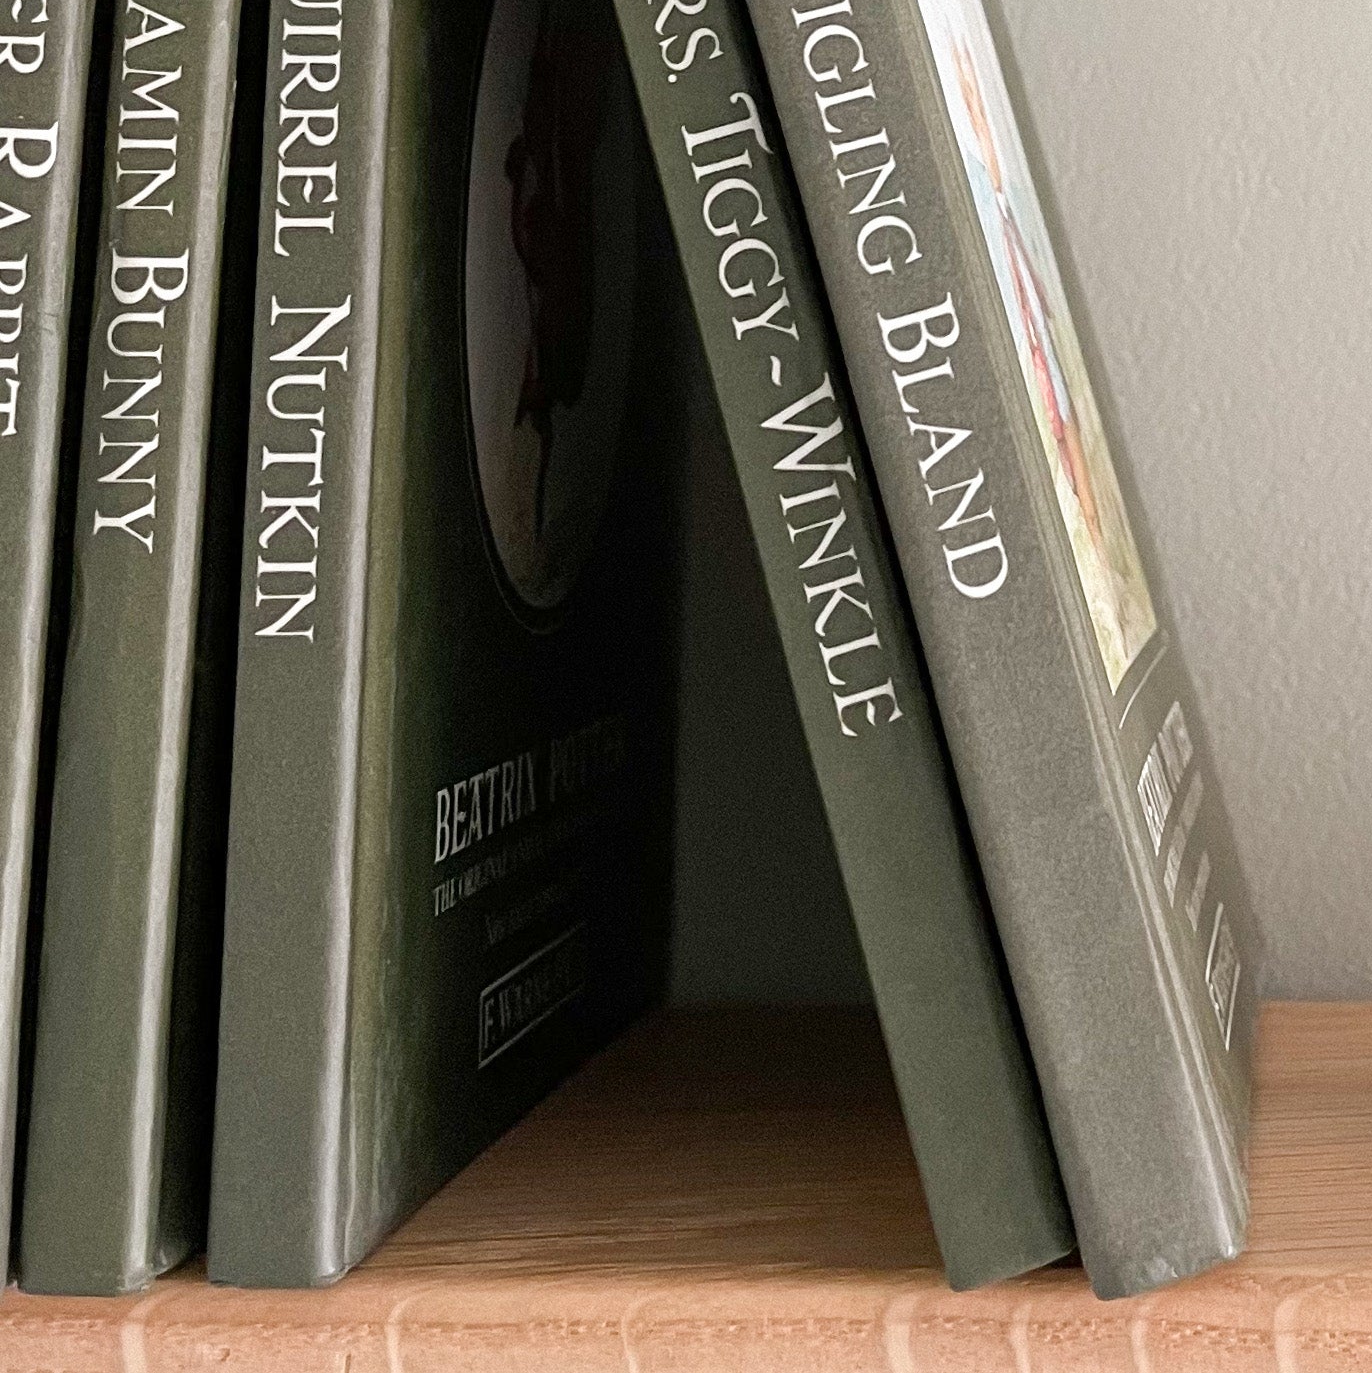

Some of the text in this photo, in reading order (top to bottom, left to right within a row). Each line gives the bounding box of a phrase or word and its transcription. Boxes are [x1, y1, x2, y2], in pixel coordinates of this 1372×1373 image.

[93, 248, 190, 554] BUNNY
[254, 294, 352, 643] NUTKIN
[876, 291, 1009, 599] BLAND
